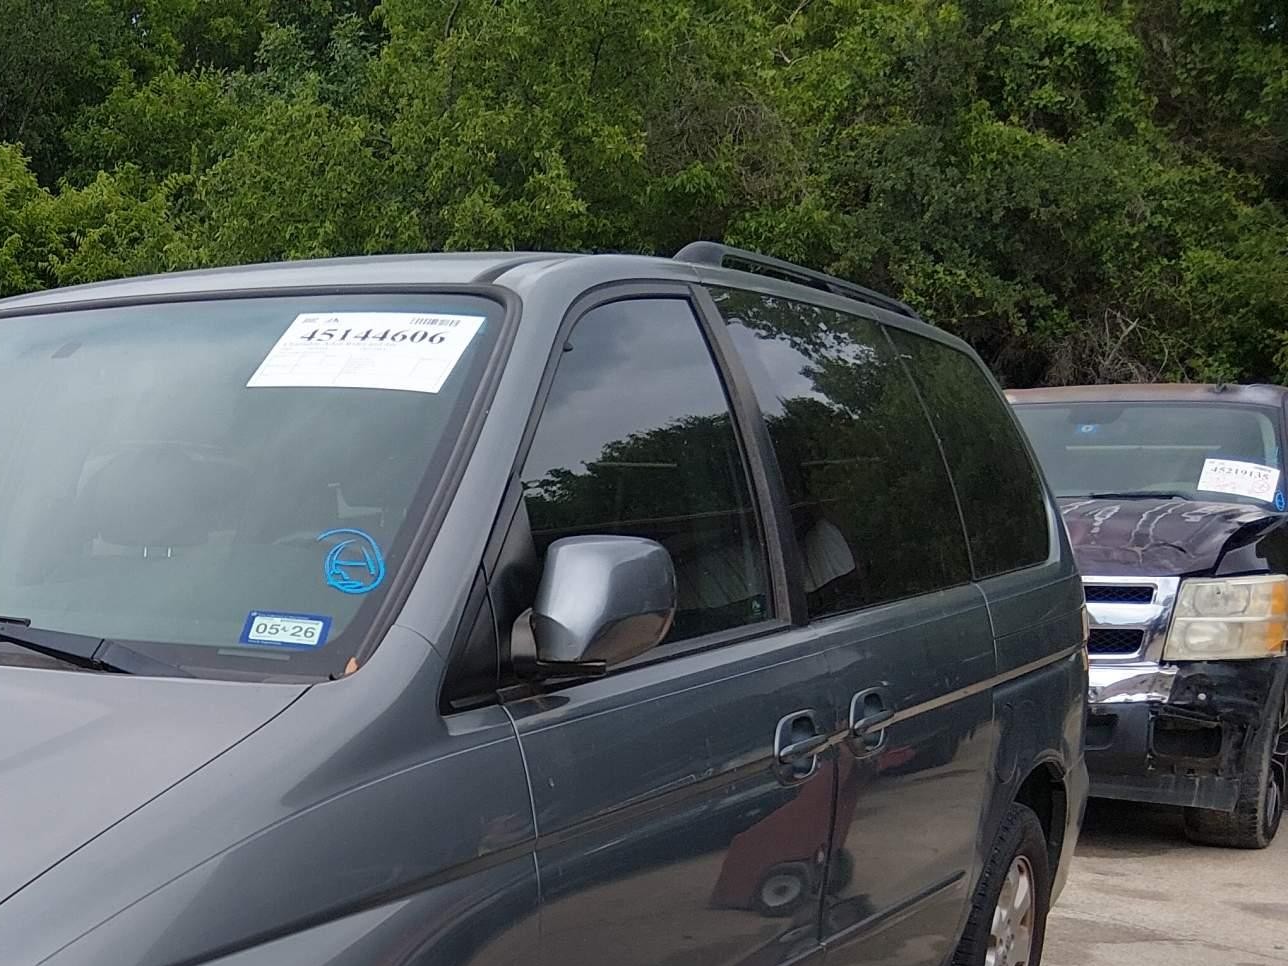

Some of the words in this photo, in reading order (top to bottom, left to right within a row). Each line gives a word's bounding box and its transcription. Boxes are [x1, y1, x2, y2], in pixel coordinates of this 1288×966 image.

[300, 327, 450, 345] 45144606
[255, 622, 281, 636] 05
[289, 625, 317, 639] 26
